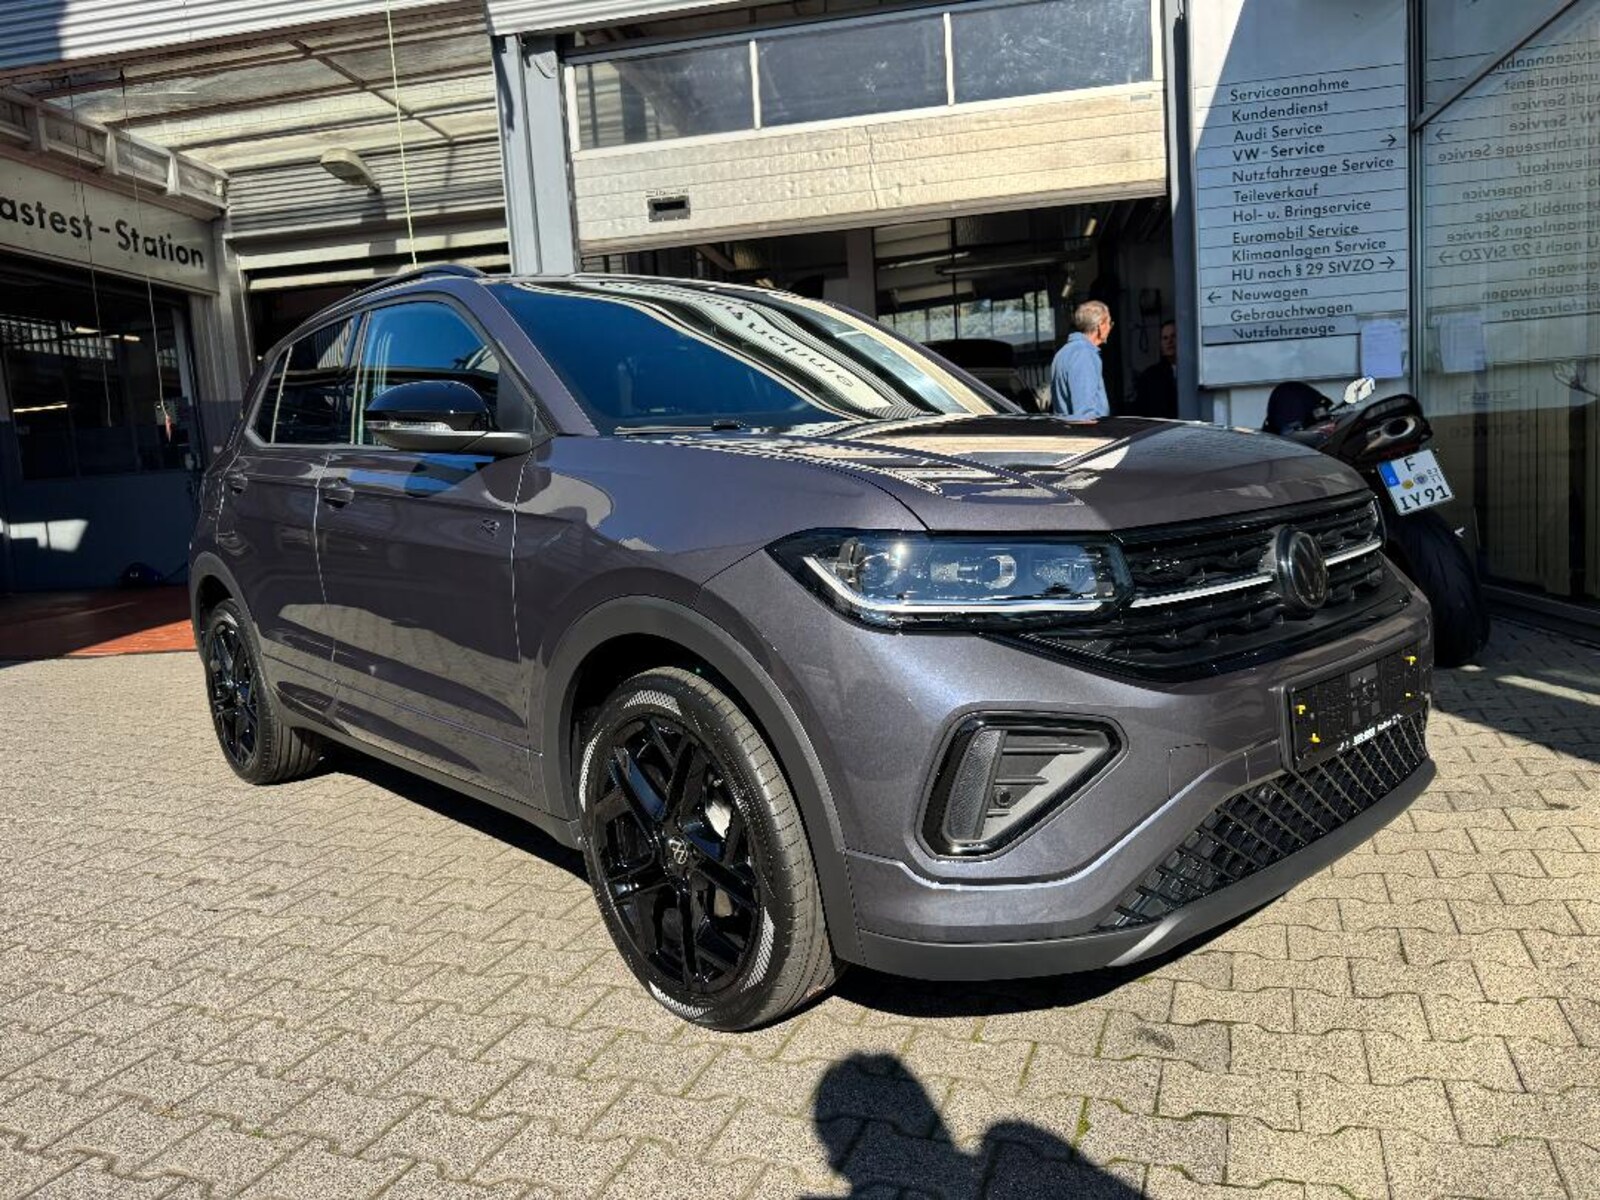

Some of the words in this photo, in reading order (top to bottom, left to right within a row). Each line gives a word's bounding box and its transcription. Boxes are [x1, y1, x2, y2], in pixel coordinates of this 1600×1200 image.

[1230, 78, 1350, 102] Serviceannahme
[1231, 101, 1329, 122] Kundendienst
[1233, 127, 1267, 143] Audi
[1271, 122, 1323, 139] Service
[1232, 163, 1337, 184] Nutzfahrzeuge
[1342, 157, 1395, 172] Service
[1233, 183, 1319, 203] Teileverkauf
[1233, 208, 1263, 223] Hol-
[1267, 212, 1280, 220] u.
[1284, 199, 1372, 219] Bringservice
[1233, 227, 1304, 244] Euromobil
[1308, 222, 1360, 237] Service
[1232, 244, 1330, 263] Klimaanlagen
[1335, 238, 1387, 253] Service
[1232, 268, 1254, 281] HU
[1258, 263, 1292, 280] nach
[1295, 263, 1302, 278] §
[1306, 262, 1324, 276] 29
[1328, 258, 1375, 274] StVZO
[1231, 286, 1309, 303] Neuwagen
[1231, 303, 1353, 323] Gebrauchtwagen
[1233, 323, 1336, 340] Nutzfahrzeuge
[1404, 456, 1415, 471] F
[1400, 492, 1421, 511] IY
[1424, 485, 1449, 502] 91
